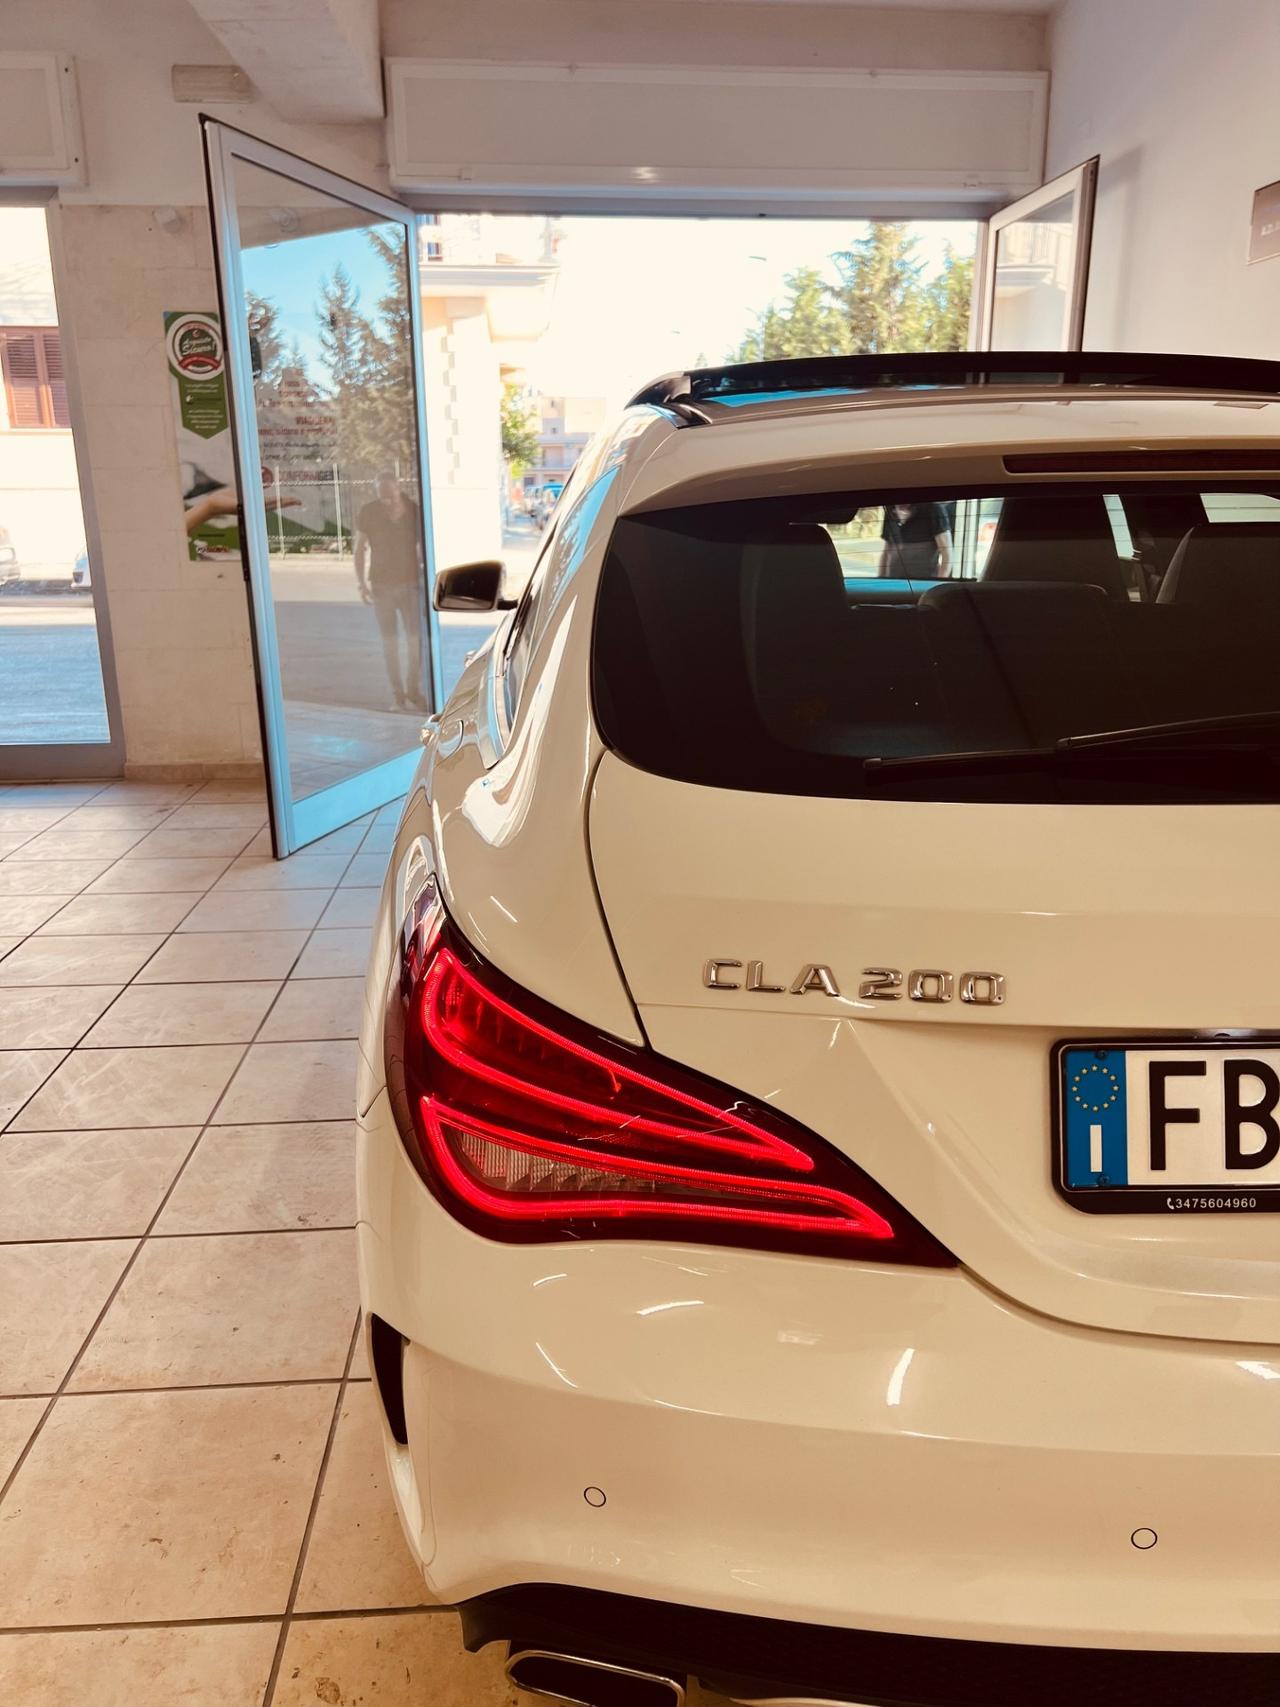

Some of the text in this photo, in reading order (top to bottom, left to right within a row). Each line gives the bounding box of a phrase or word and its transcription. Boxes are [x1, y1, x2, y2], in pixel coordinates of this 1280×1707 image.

[703, 958, 1007, 1006] CLA 200
[1149, 1059, 1280, 1171] FB
[1090, 1124, 1102, 1172] I
[1175, 1198, 1257, 1209] 3475604960
